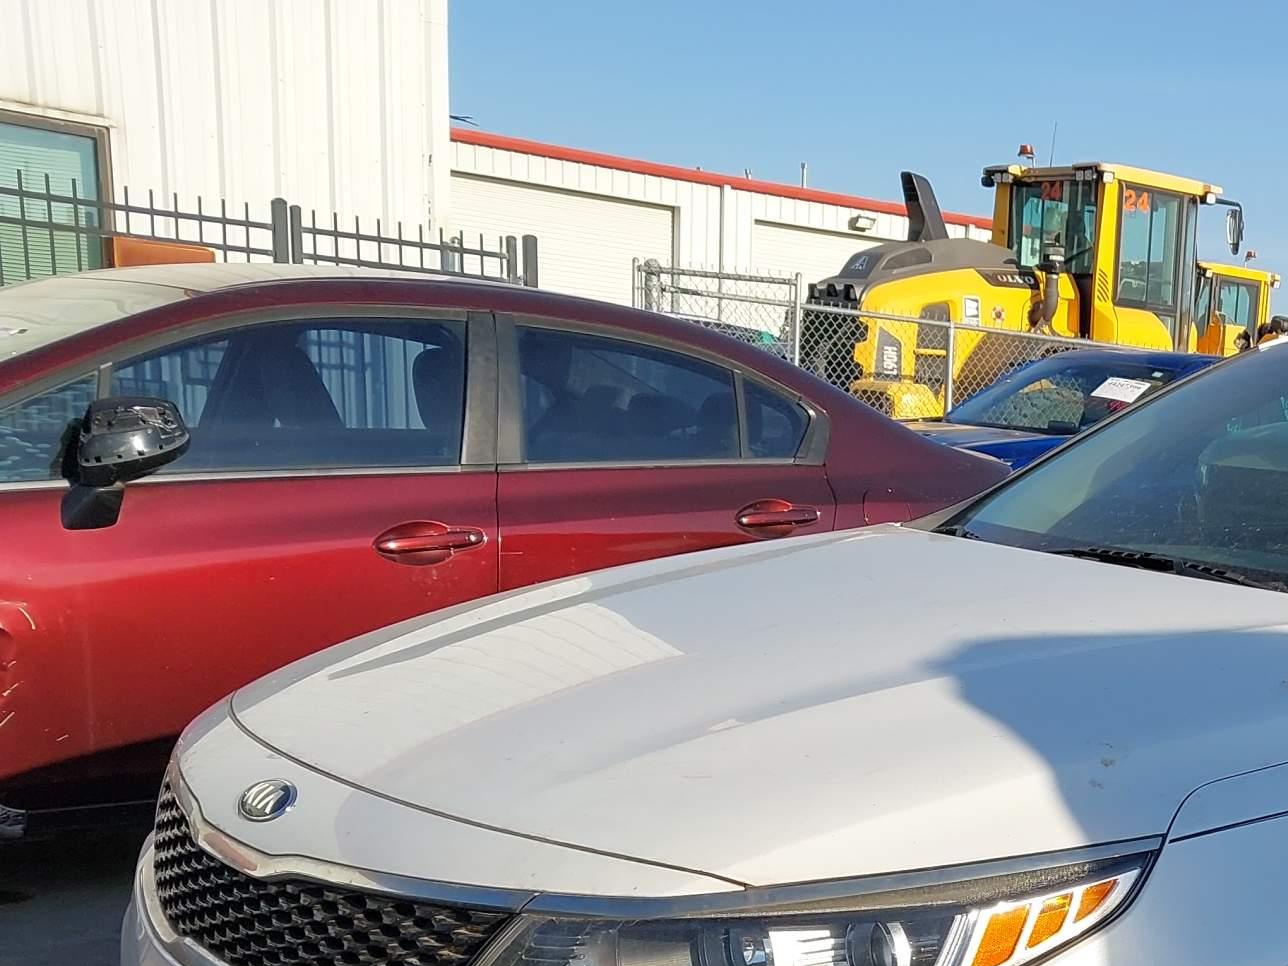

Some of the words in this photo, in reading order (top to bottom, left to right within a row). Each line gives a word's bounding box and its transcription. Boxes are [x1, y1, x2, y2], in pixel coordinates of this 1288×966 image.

[1041, 181, 1060, 200] 24
[1124, 189, 1149, 213] 24
[243, 783, 286, 814] KIA
